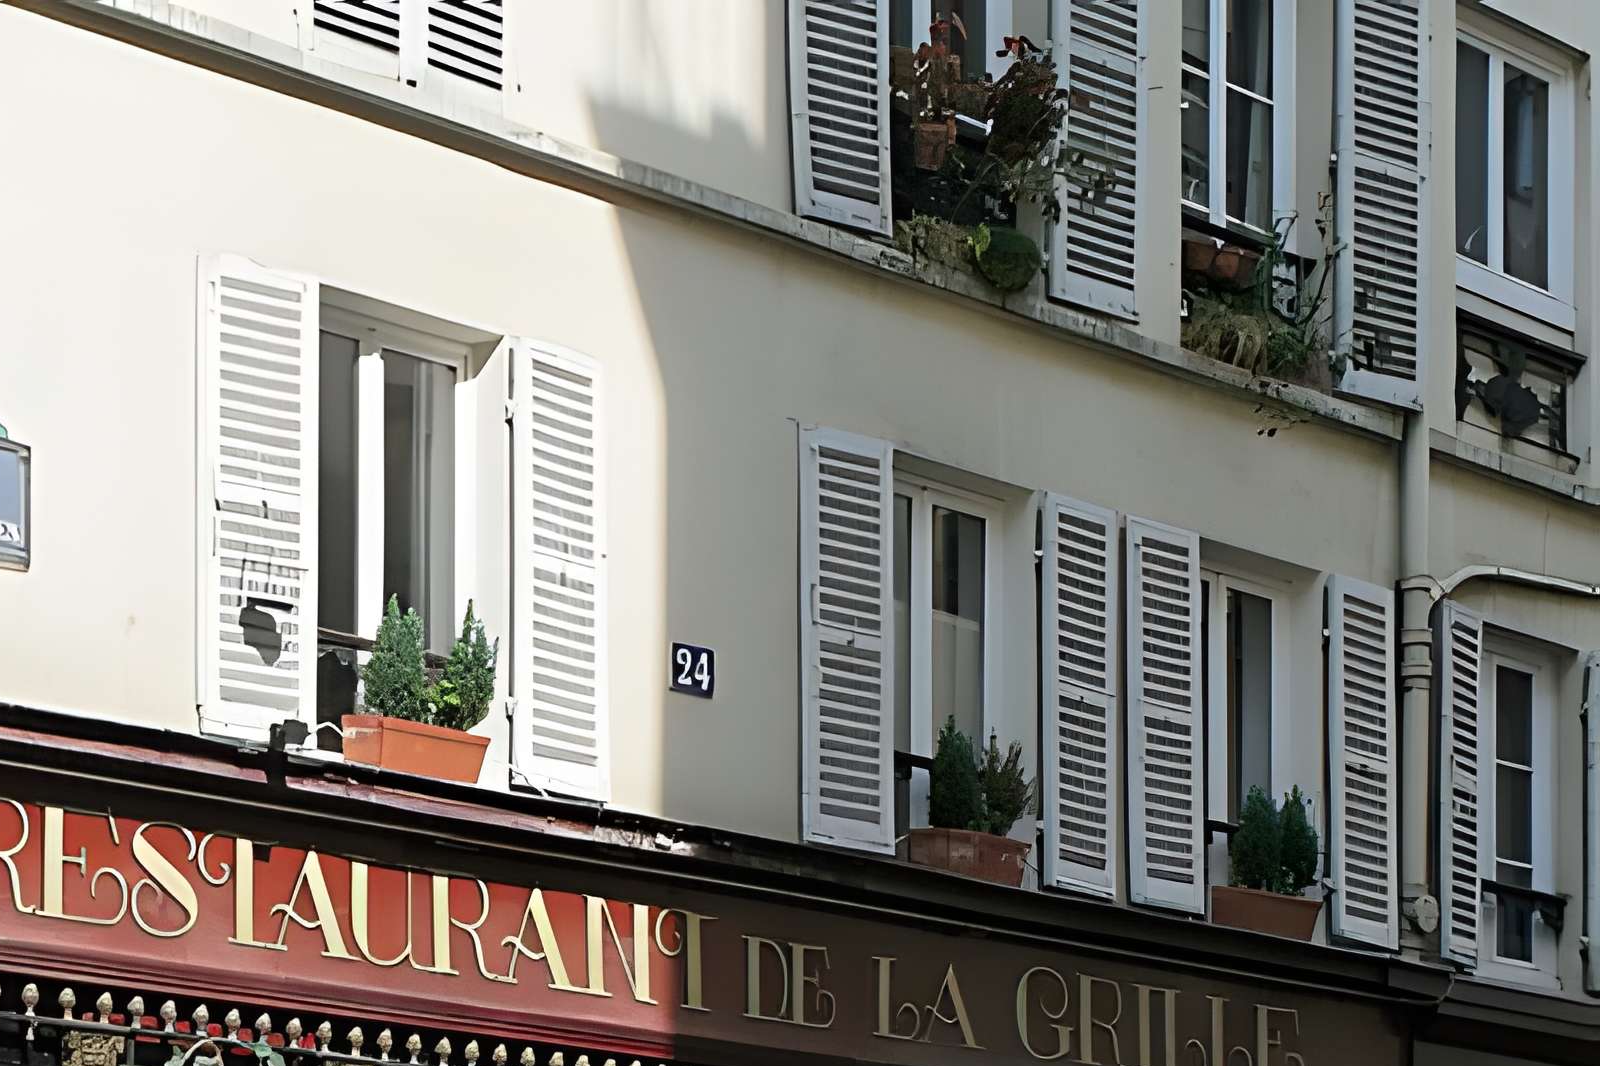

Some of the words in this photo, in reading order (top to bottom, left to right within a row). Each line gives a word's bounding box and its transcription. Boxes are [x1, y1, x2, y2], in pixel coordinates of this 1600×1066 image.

[677, 648, 711, 691] 24
[742, 934, 837, 1029] DE
[872, 955, 986, 1050] LA
